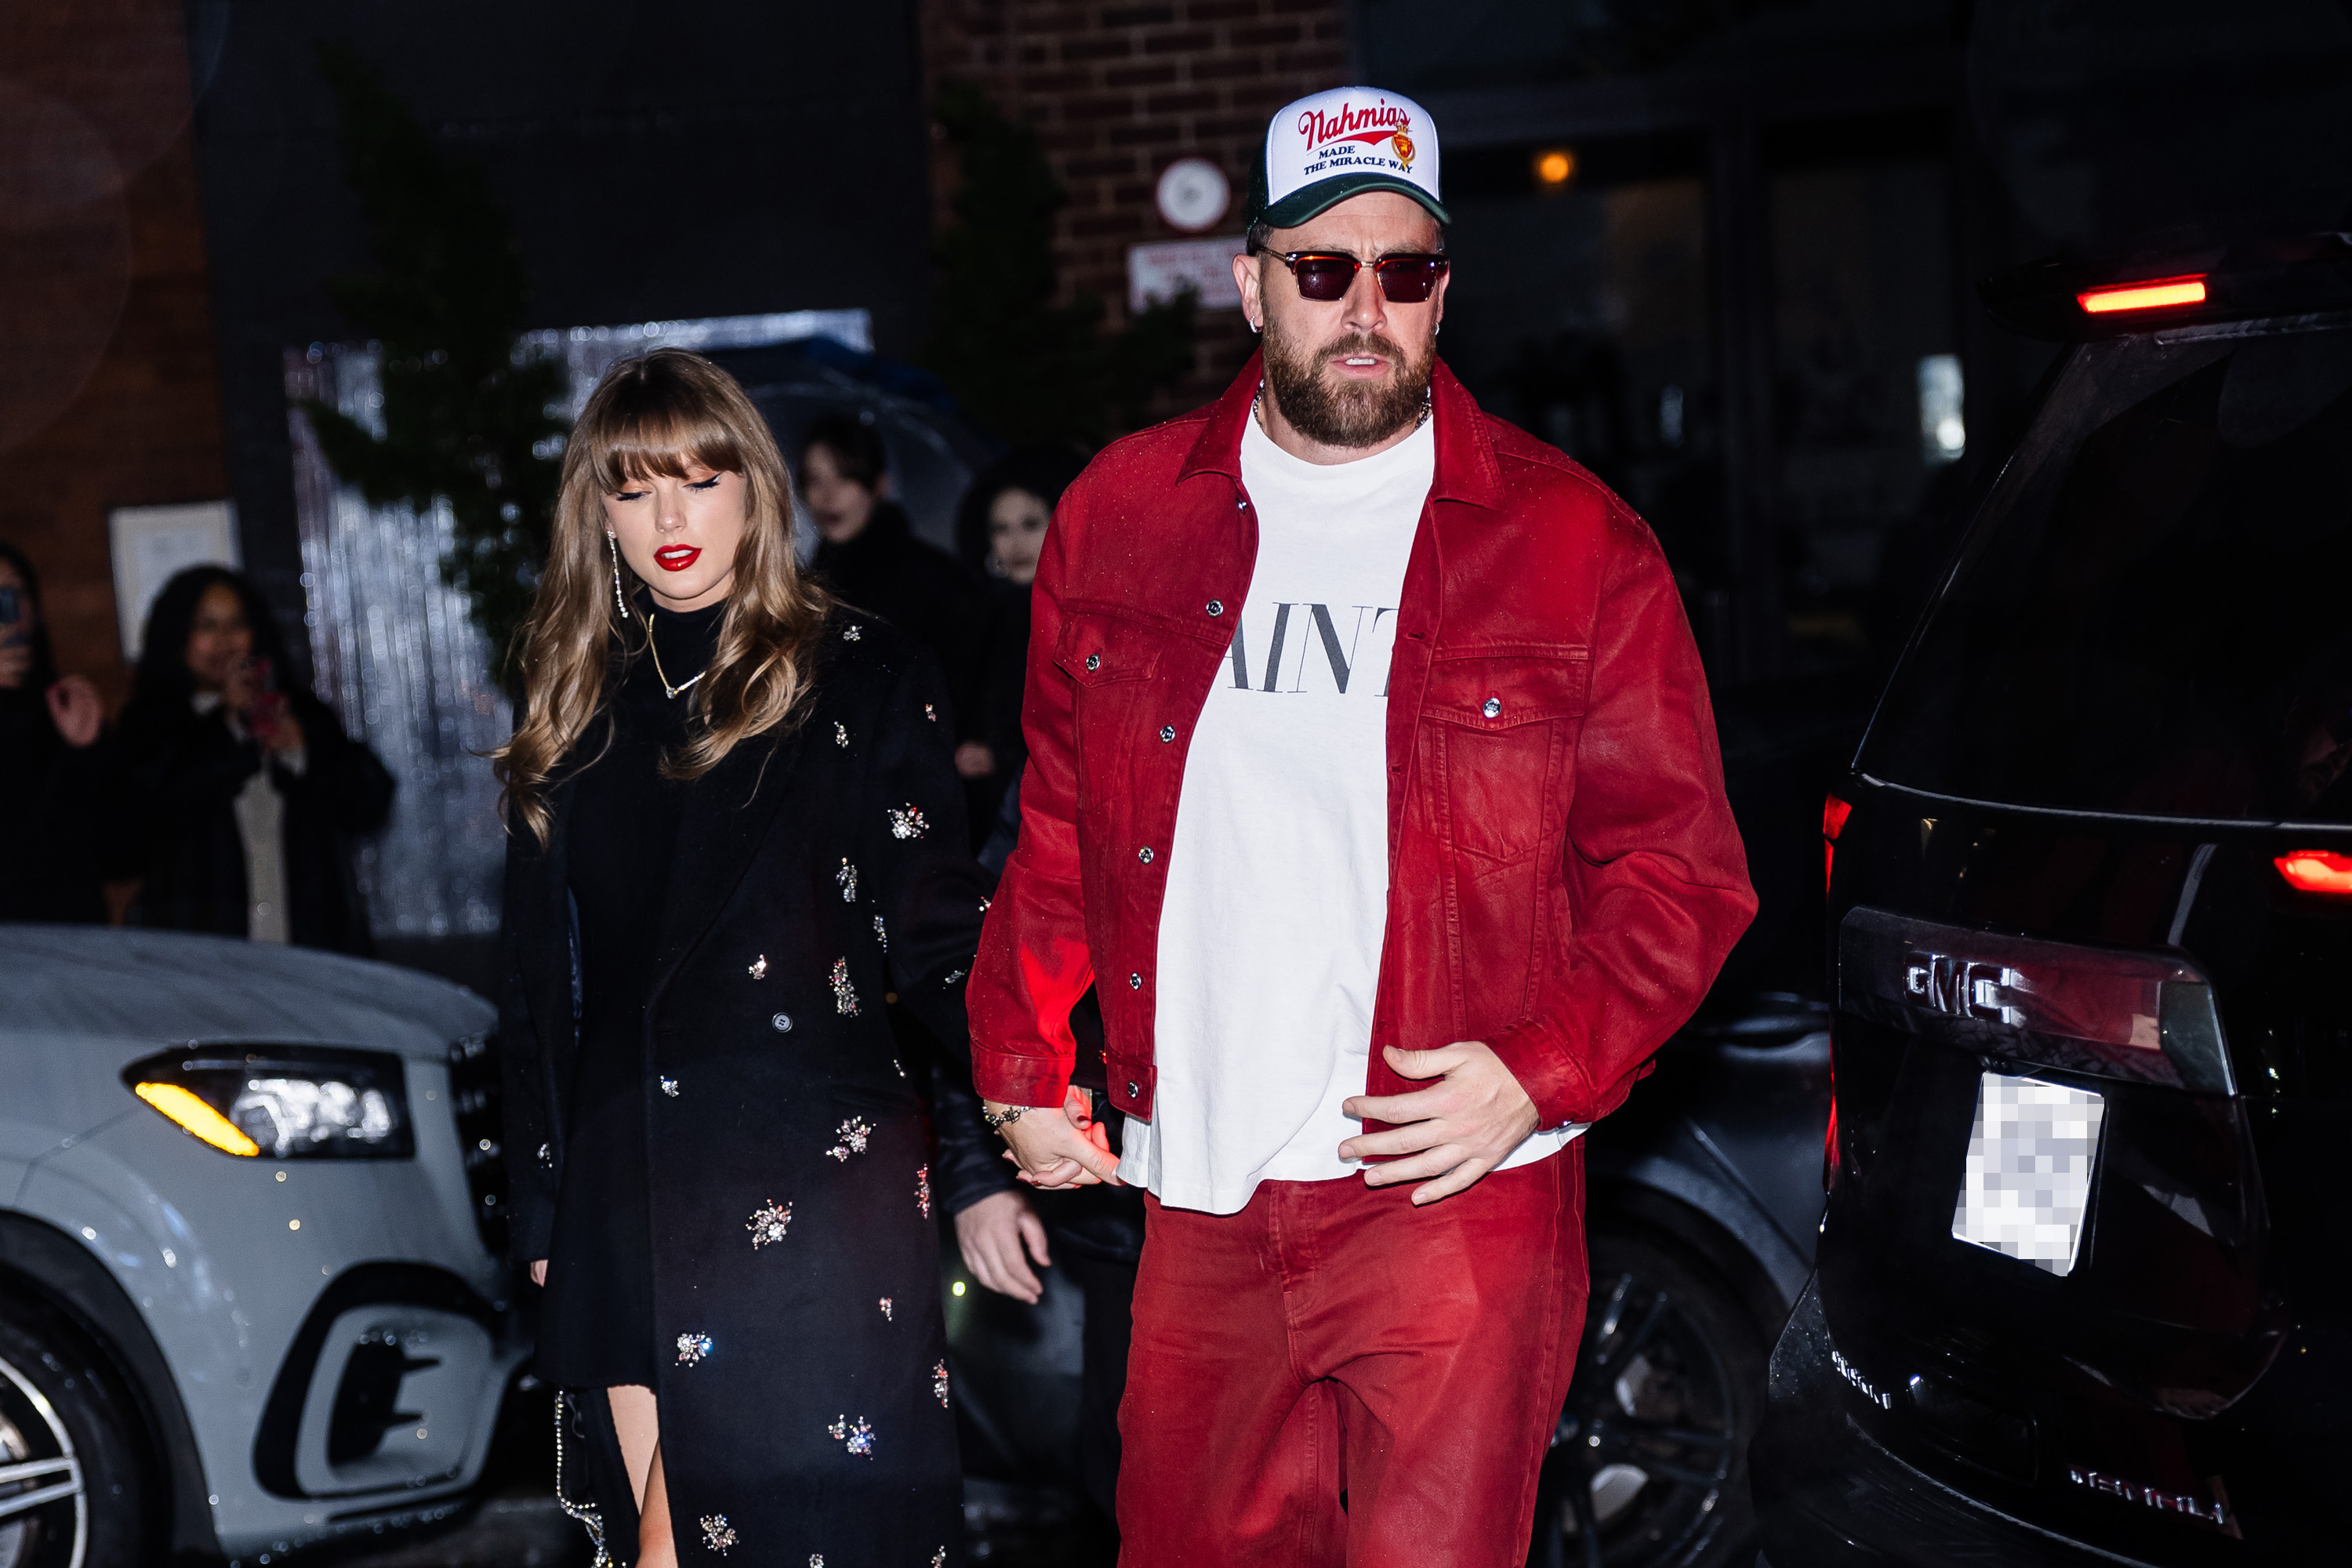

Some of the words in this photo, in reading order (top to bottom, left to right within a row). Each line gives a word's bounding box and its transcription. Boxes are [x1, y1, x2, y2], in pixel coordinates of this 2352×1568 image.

[1298, 98, 1410, 151] Nahmias
[1304, 162, 1327, 176] THE
[1330, 156, 1385, 167] MIRACLE
[1388, 159, 1413, 173] WAY
[1319, 146, 1356, 159] MADE
[1904, 949, 2012, 1025] GMC
